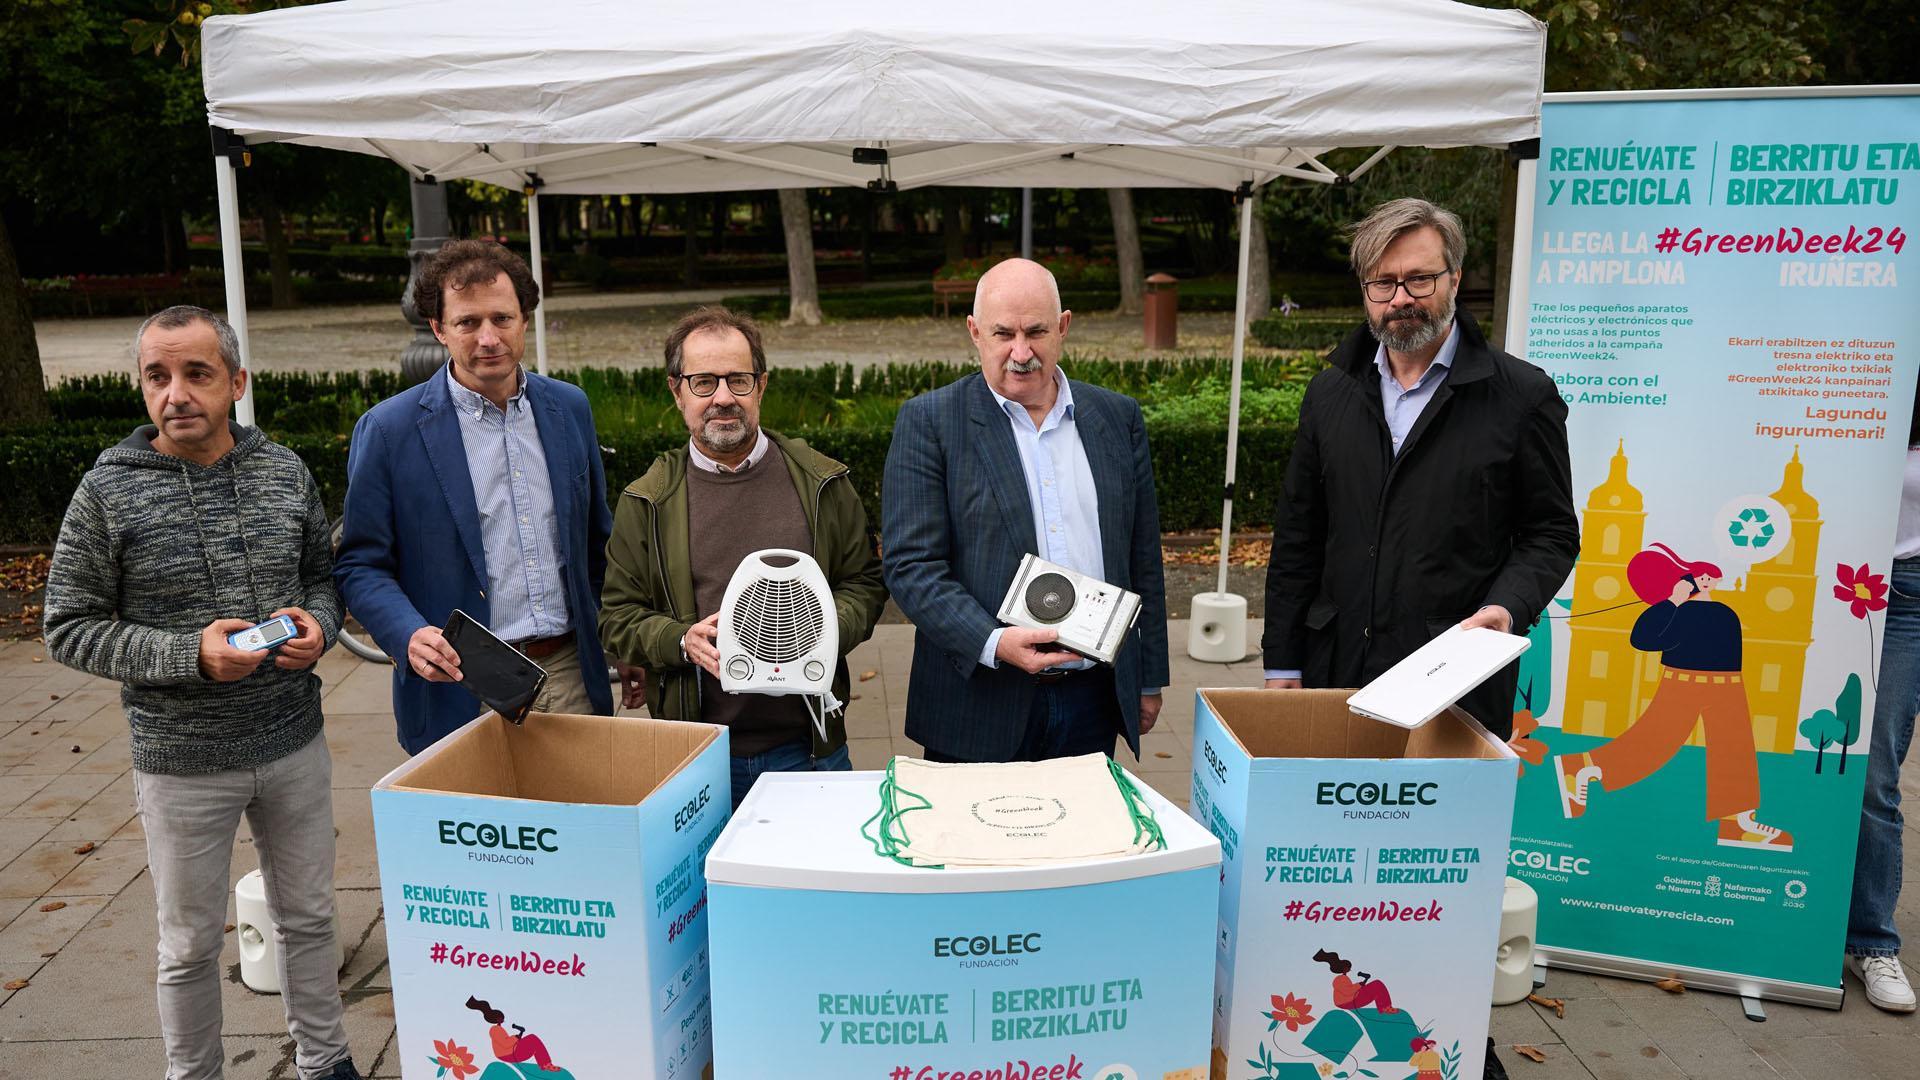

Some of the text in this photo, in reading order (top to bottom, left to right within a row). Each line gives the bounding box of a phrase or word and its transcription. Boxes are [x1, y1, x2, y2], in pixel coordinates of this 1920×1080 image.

[1549, 141, 1696, 171] RENUÉVATE
[1730, 142, 1920, 172] BERRITU ETA
[1547, 178, 1691, 206] Y RECICLA
[1726, 178, 1898, 206] BIRZIKLATU
[1542, 225, 1907, 256] LLEGA LA #GreenWeek24
[1536, 260, 1686, 286] A PAMPLONA
[1779, 256, 1898, 287] IRUÑERA
[1533, 303, 1688, 314] Trae los pequeños aparatos
[1531, 315, 1693, 326] eléctricos y electrónicos que
[1530, 328, 1542, 336] ya
[1546, 328, 1560, 336] no
[1602, 328, 1617, 336] los
[1620, 329, 1660, 338] puntos
[1529, 339, 1584, 348] adheridos
[1598, 340, 1607, 348] la
[1610, 340, 1663, 350] campaña
[1728, 338, 1895, 348] Ekarri erabiltzen ez dituzun
[1528, 351, 1618, 360] #GreenWeek24.
[1774, 351, 1812, 360] tresna
[1816, 352, 1870, 360] elektriko
[1776, 363, 1892, 374] elektroniko txikiak
[1608, 376, 1638, 386] con
[1644, 375, 1659, 387] el
[1728, 375, 1891, 386] #GreenWeek24 kanpainari
[1578, 392, 1667, 406] Ambiente!
[1758, 387, 1889, 399] atxikitako guneetara.
[1806, 406, 1887, 422] Lagundu
[1756, 422, 1885, 439] ingurumenari!
[1204, 740, 1227, 784] ECOLEC
[1316, 782, 1438, 806] ECOLEC
[674, 784, 710, 832] ECOLEC
[1343, 808, 1410, 820] FUNDACIÓN
[438, 820, 558, 852] ECOLEC
[468, 852, 534, 865] FUNDACIÓN
[1266, 844, 1356, 863] RENUÉVATE
[1378, 847, 1480, 864] BERRITU ETA
[1265, 866, 1354, 883] Y RECICLA
[1376, 867, 1468, 884] BIRZIKLATU
[1679, 857, 1700, 865] apoyo
[1702, 859, 1758, 871] de/Gobernuaren
[1760, 866, 1810, 876] laguntzarekin:
[1517, 870, 1569, 883] FUNDACIÓN
[1664, 876, 1702, 887] Gobierno
[402, 884, 488, 907] RENUÉVATE
[1668, 886, 1701, 895] Navarra
[1724, 883, 1772, 895] Nafarroako
[1724, 891, 1765, 902] Gobernua
[510, 894, 616, 918] BERRITU ETA
[1284, 900, 1442, 923] #GreenWeek
[1560, 897, 1734, 926] www.renuevateyrecicla.com
[405, 905, 490, 929] Y RECICLA
[512, 915, 606, 939] BIRZIKLATU
[934, 932, 1041, 958] ECOLEC
[430, 942, 586, 977] #GreenWeek
[959, 957, 1019, 969] FUNDACIÓN
[818, 989, 949, 1015] RENUÉVATE
[992, 978, 1143, 1014] BERRITU ETA
[820, 1021, 949, 1045] Y RECICLA
[992, 1009, 1128, 1042] BIRZIKLATU
[890, 1054, 1083, 1080] #GreenWeek
